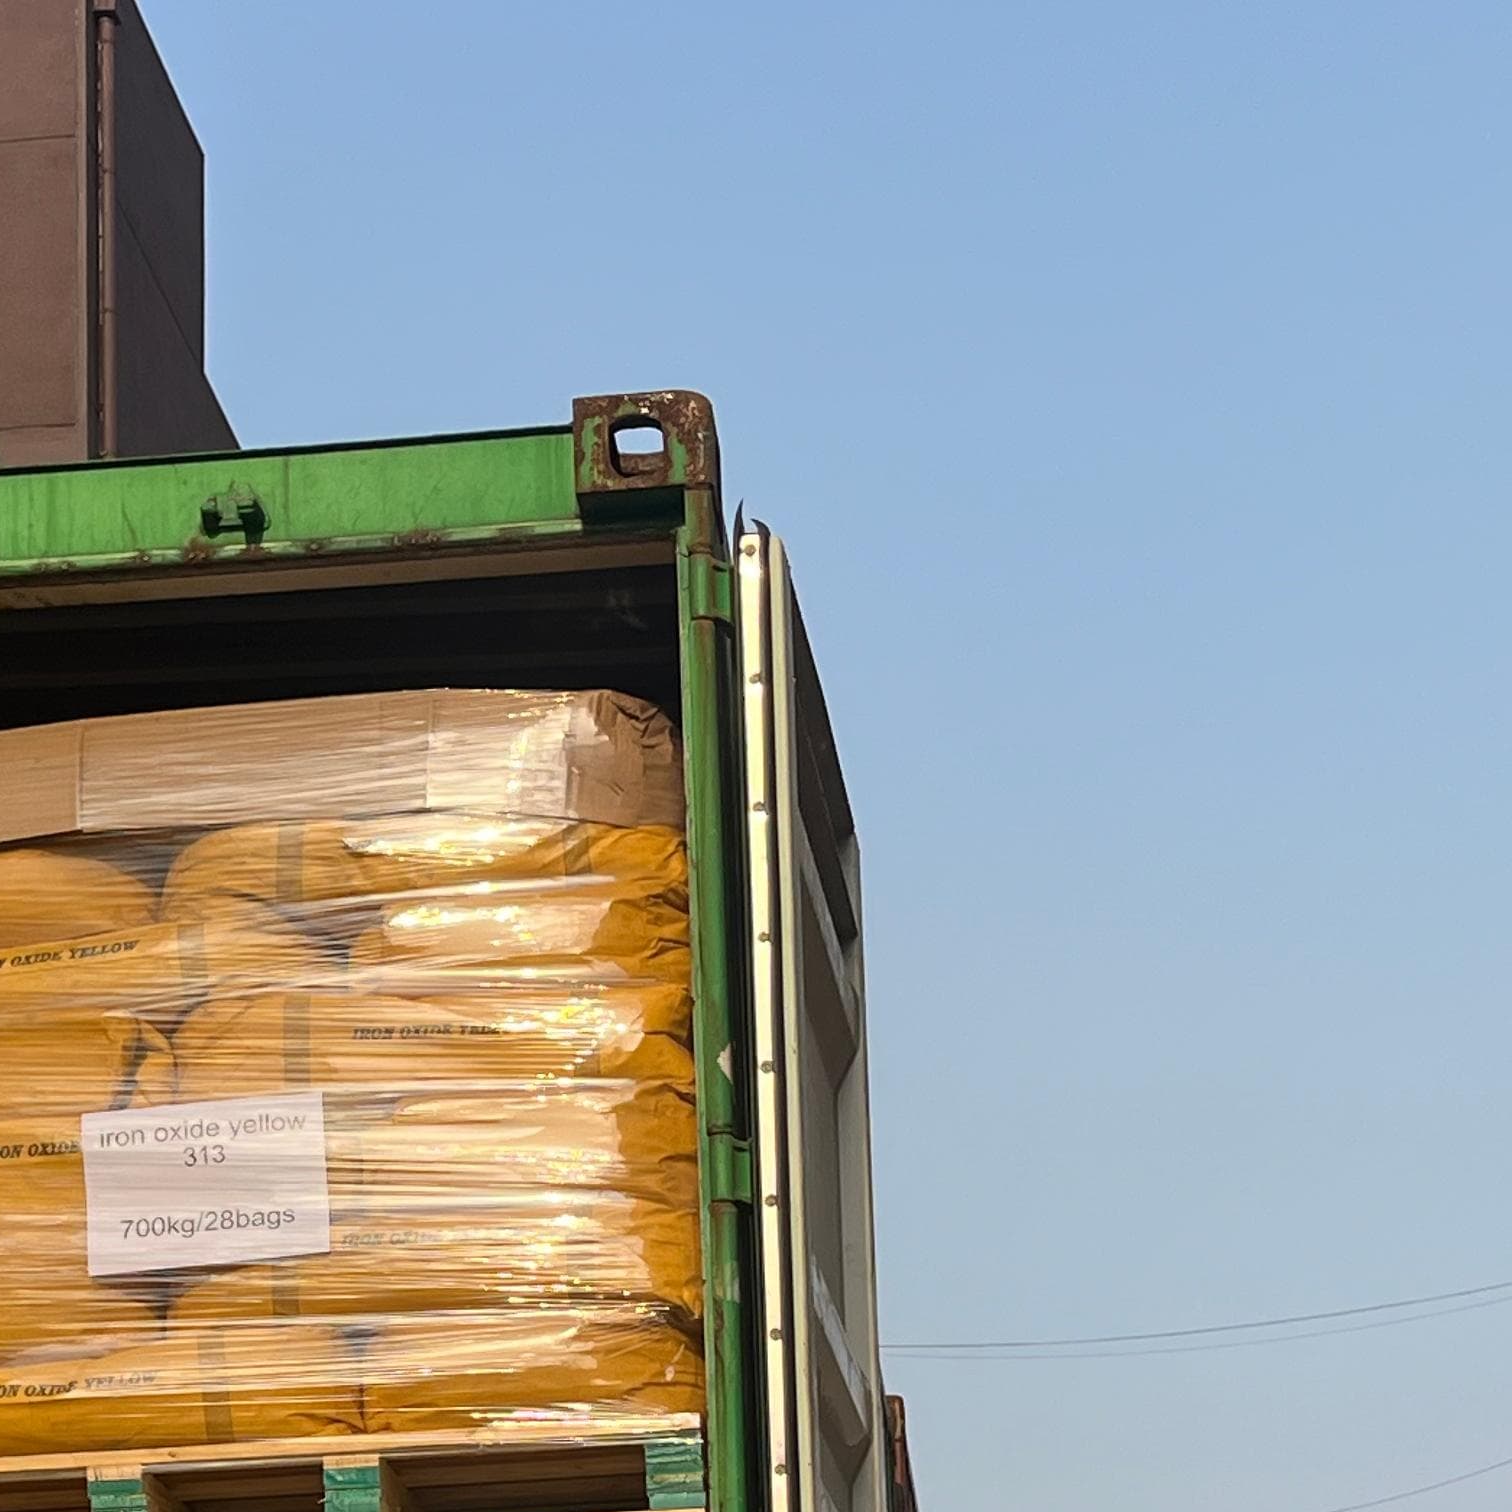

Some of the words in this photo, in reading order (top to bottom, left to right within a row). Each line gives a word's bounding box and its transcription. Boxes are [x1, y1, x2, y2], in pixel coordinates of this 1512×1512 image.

[10, 950, 63, 968] OXIDE
[68, 940, 141, 960] YELLOW
[100, 1128, 145, 1149] iron
[154, 1117, 221, 1143] oxide
[229, 1112, 307, 1138] yellow
[183, 1145, 226, 1168] 313
[120, 1208, 296, 1240] 700kg/28bags
